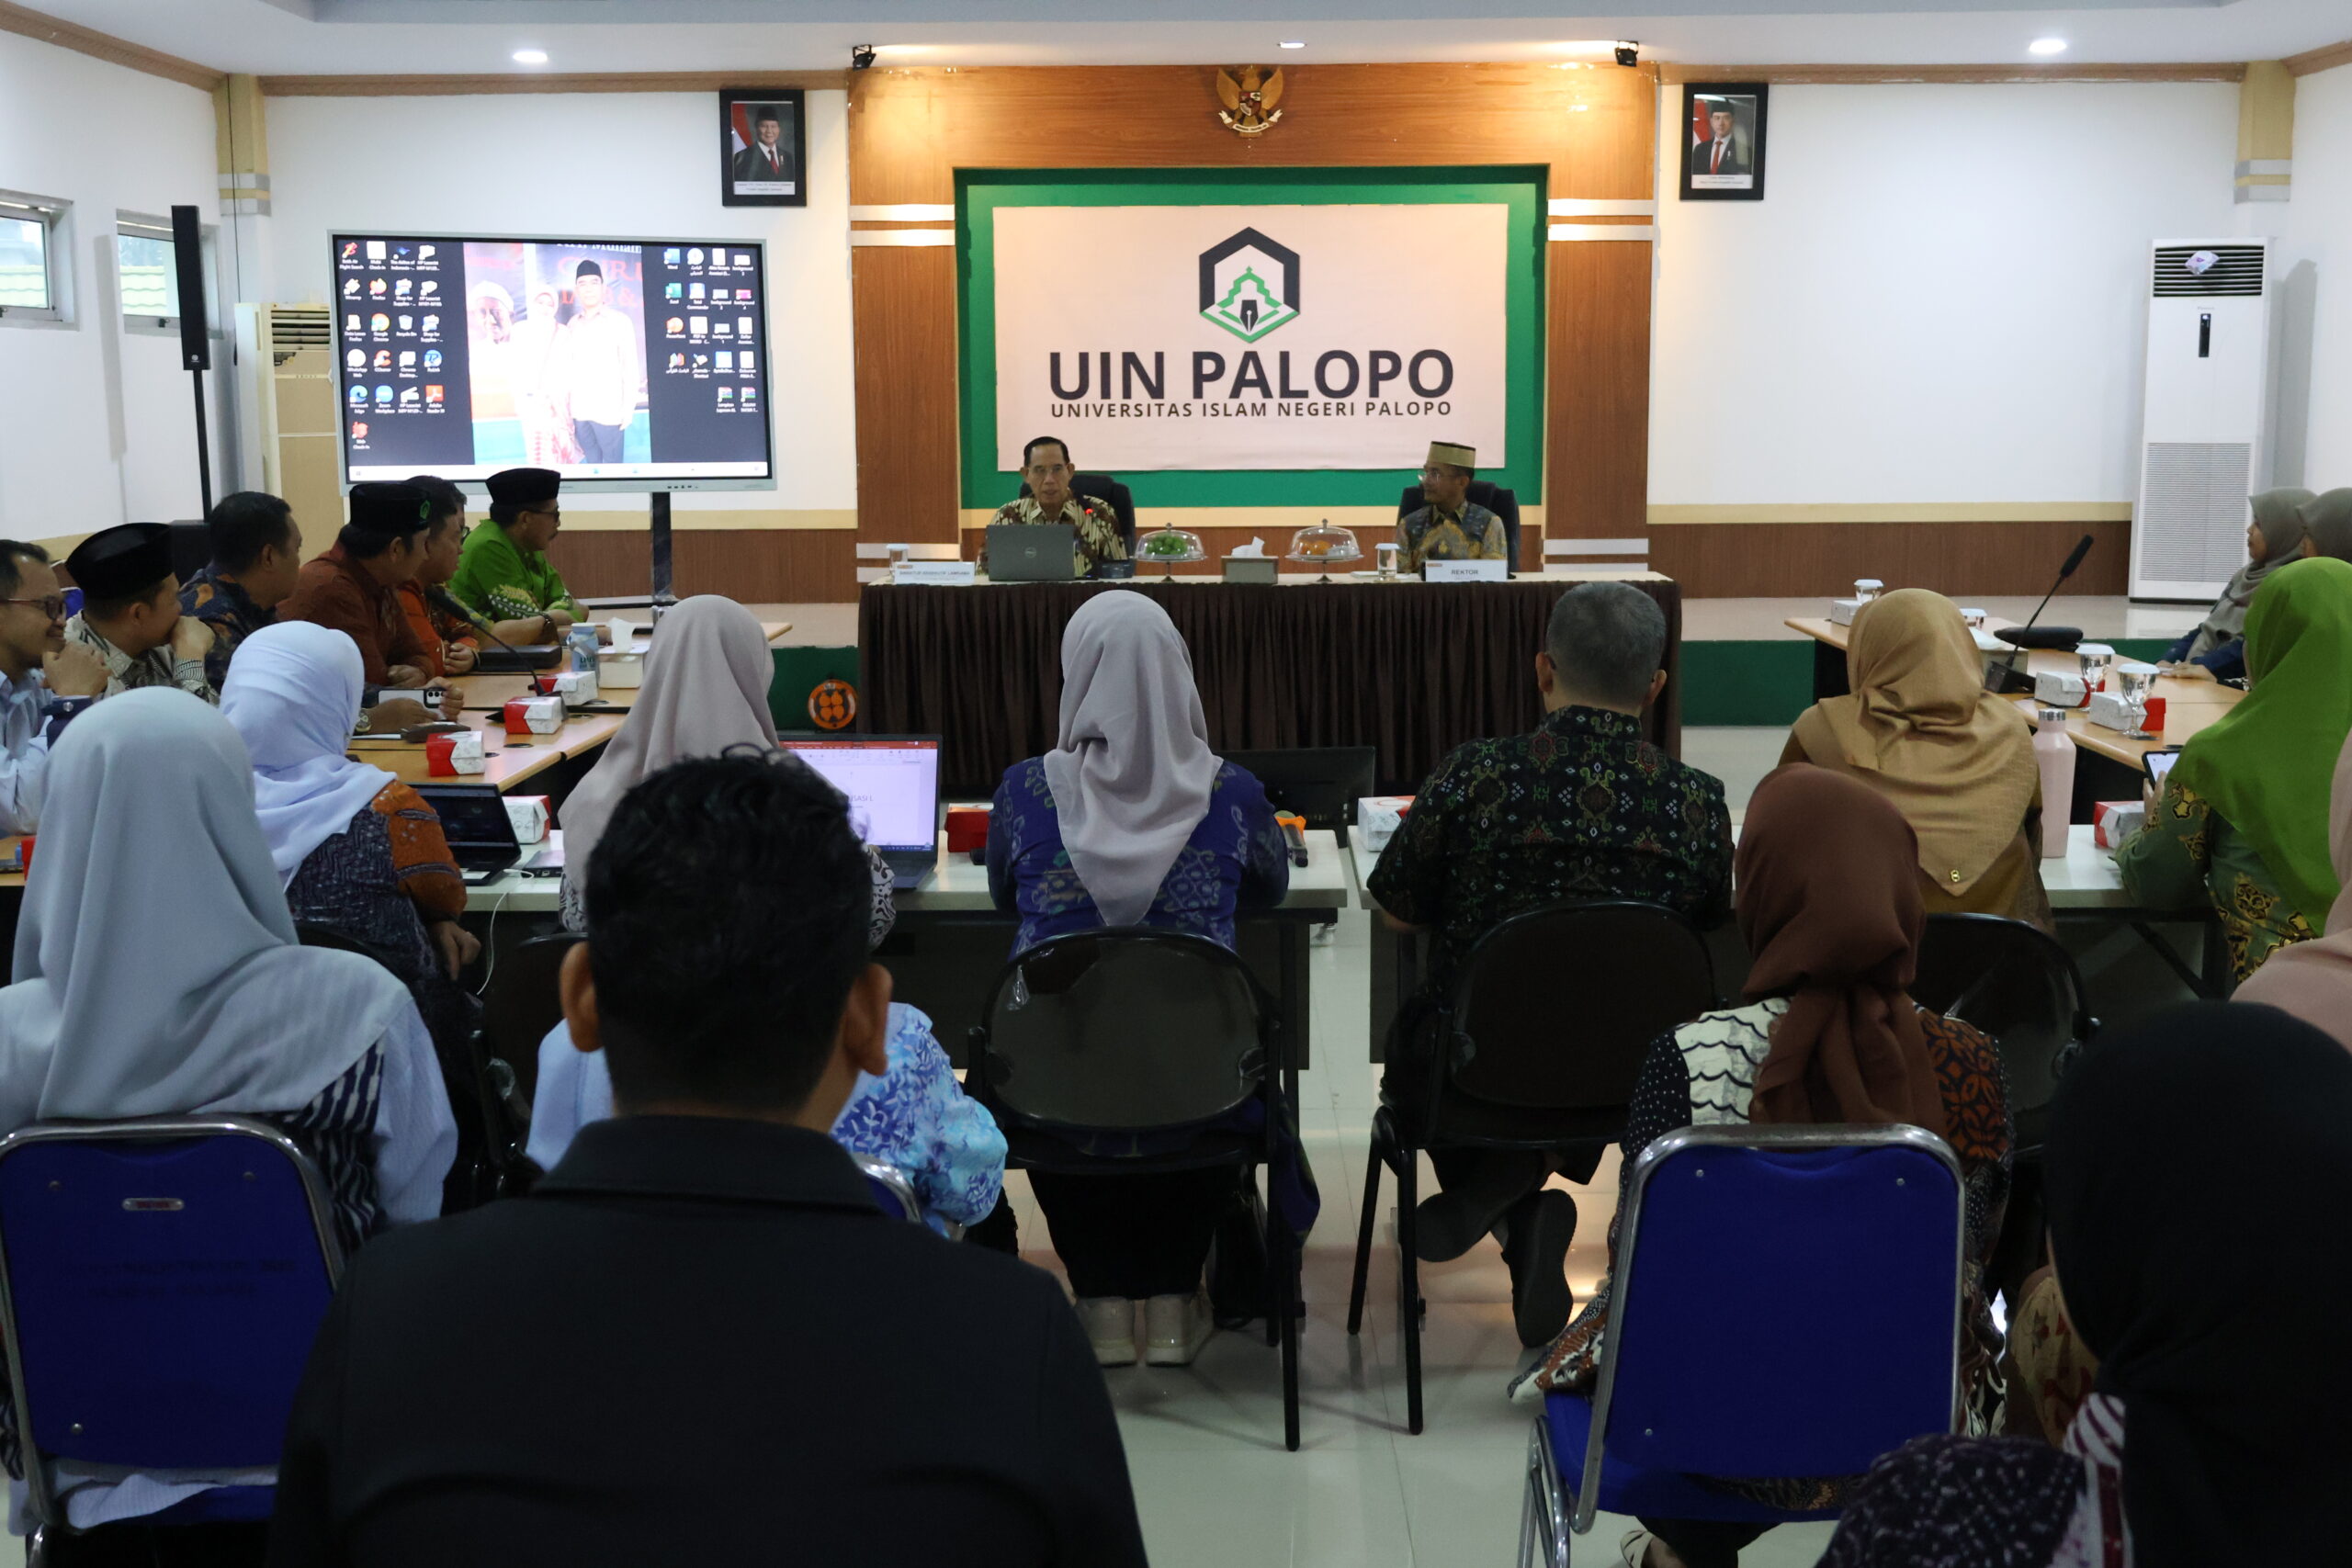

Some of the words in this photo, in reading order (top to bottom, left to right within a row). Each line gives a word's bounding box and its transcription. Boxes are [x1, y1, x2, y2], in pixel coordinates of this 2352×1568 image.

[1049, 351, 1165, 400] UIN
[1193, 349, 1453, 400] PALOPO
[1051, 402, 1192, 418] UNIVERSITAS
[1203, 402, 1268, 417] ISLAM
[1277, 402, 1355, 416] NEGERI
[1365, 401, 1452, 416] PALOPO
